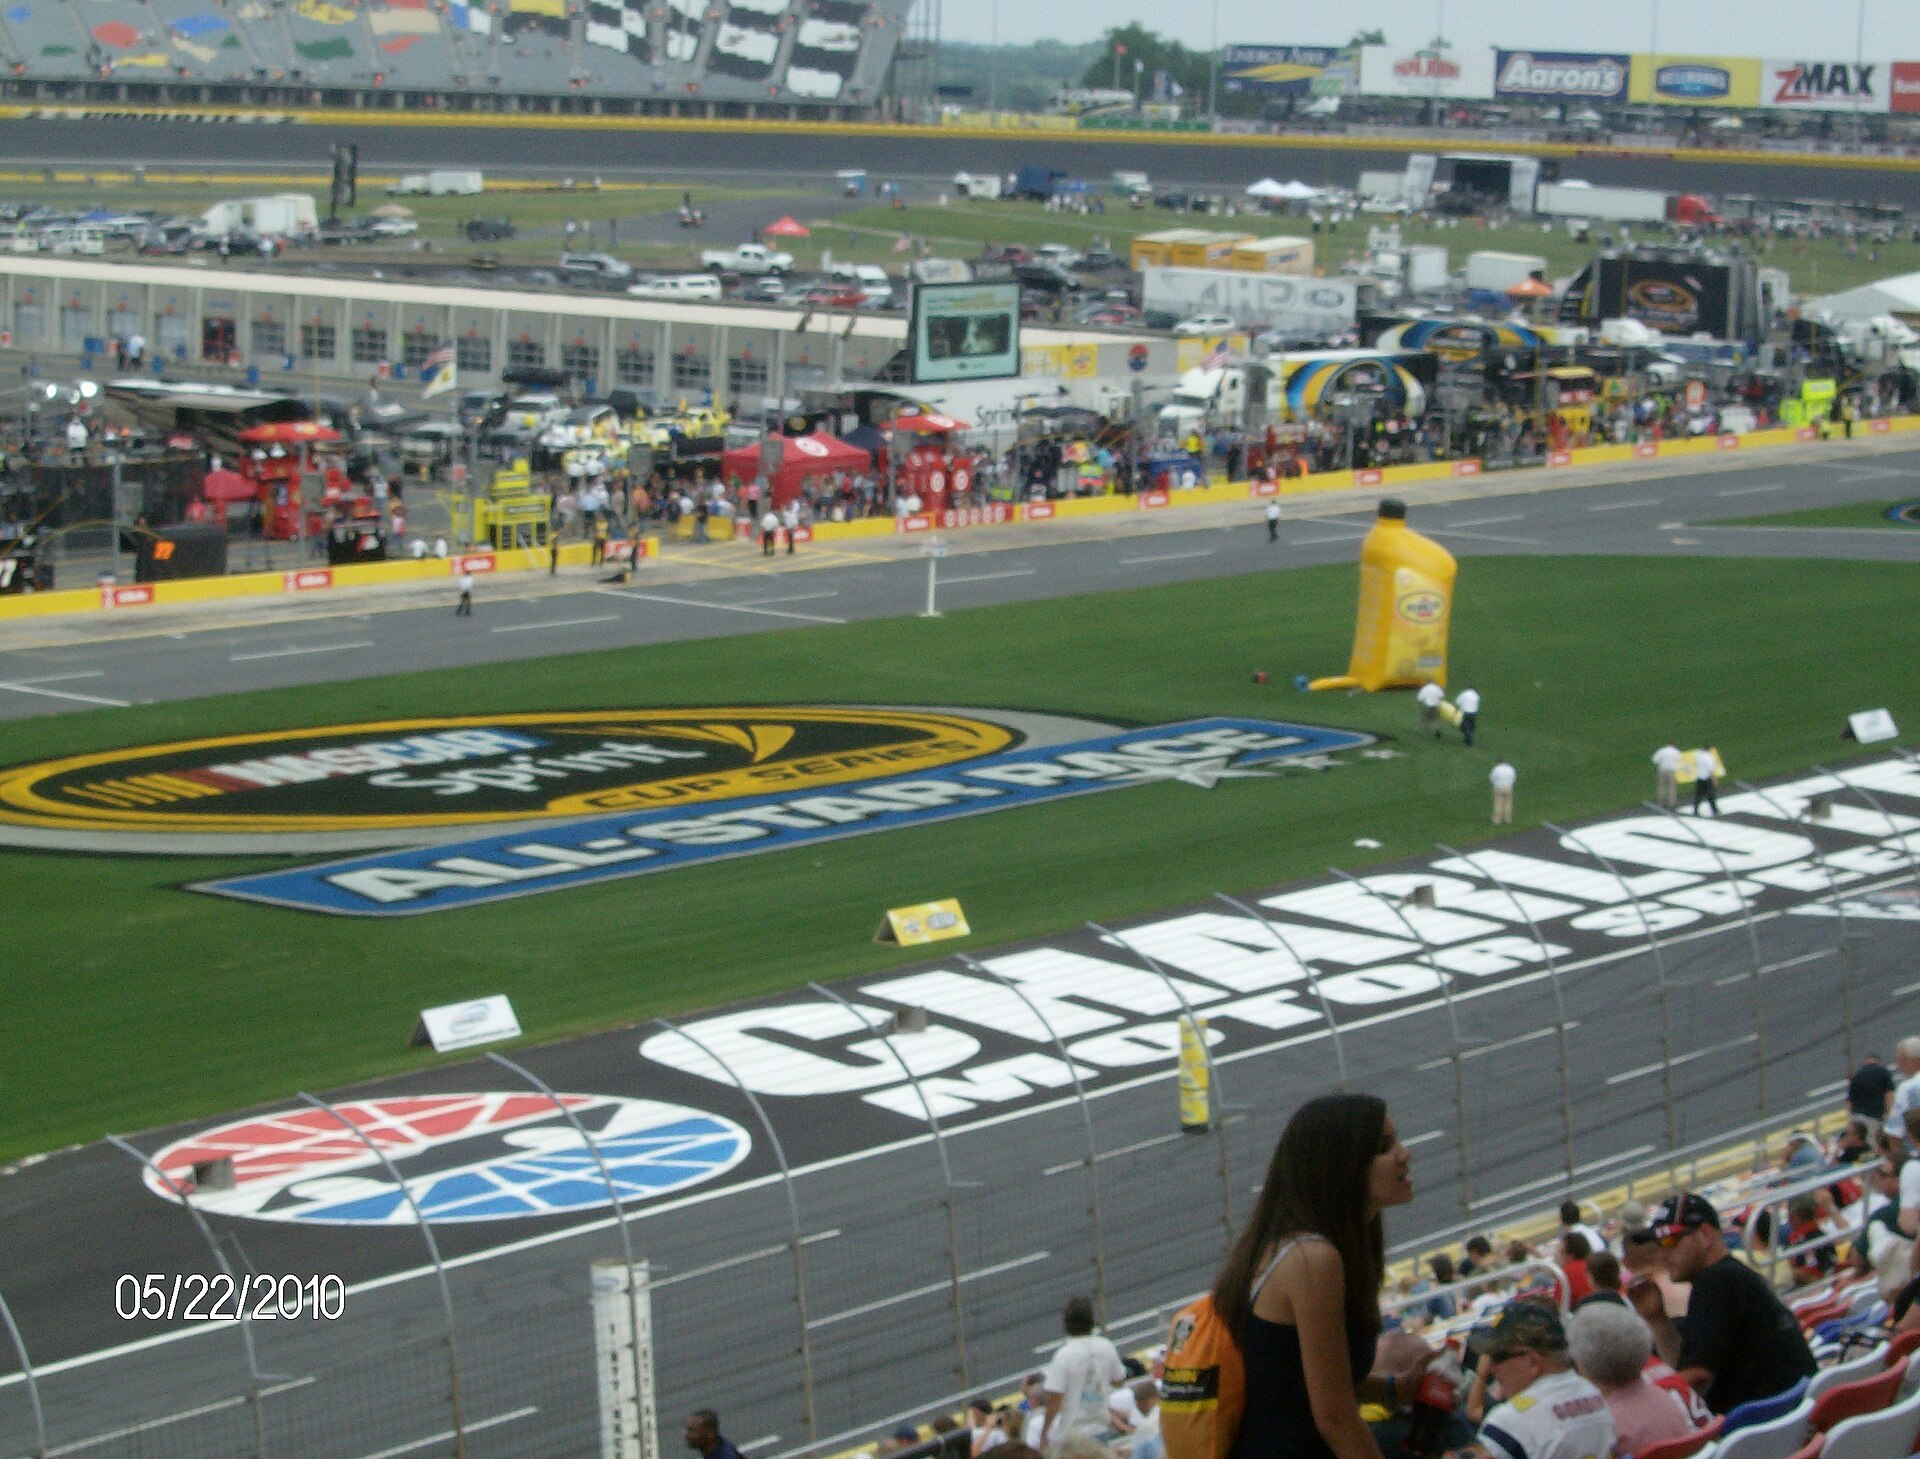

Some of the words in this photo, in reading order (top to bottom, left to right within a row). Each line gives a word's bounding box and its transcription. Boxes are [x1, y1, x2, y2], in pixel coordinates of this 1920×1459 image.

[1505, 59, 1621, 93] Aaron's
[975, 404, 1019, 432] Sprin
[207, 728, 544, 787] NASCAR
[367, 741, 706, 795] Sprint
[585, 777, 731, 809] CUP
[746, 739, 977, 784] SERIES
[325, 778, 1004, 904] ALL-STAR
[962, 727, 1308, 788] RACE
[861, 934, 1573, 1121] MOTOR
